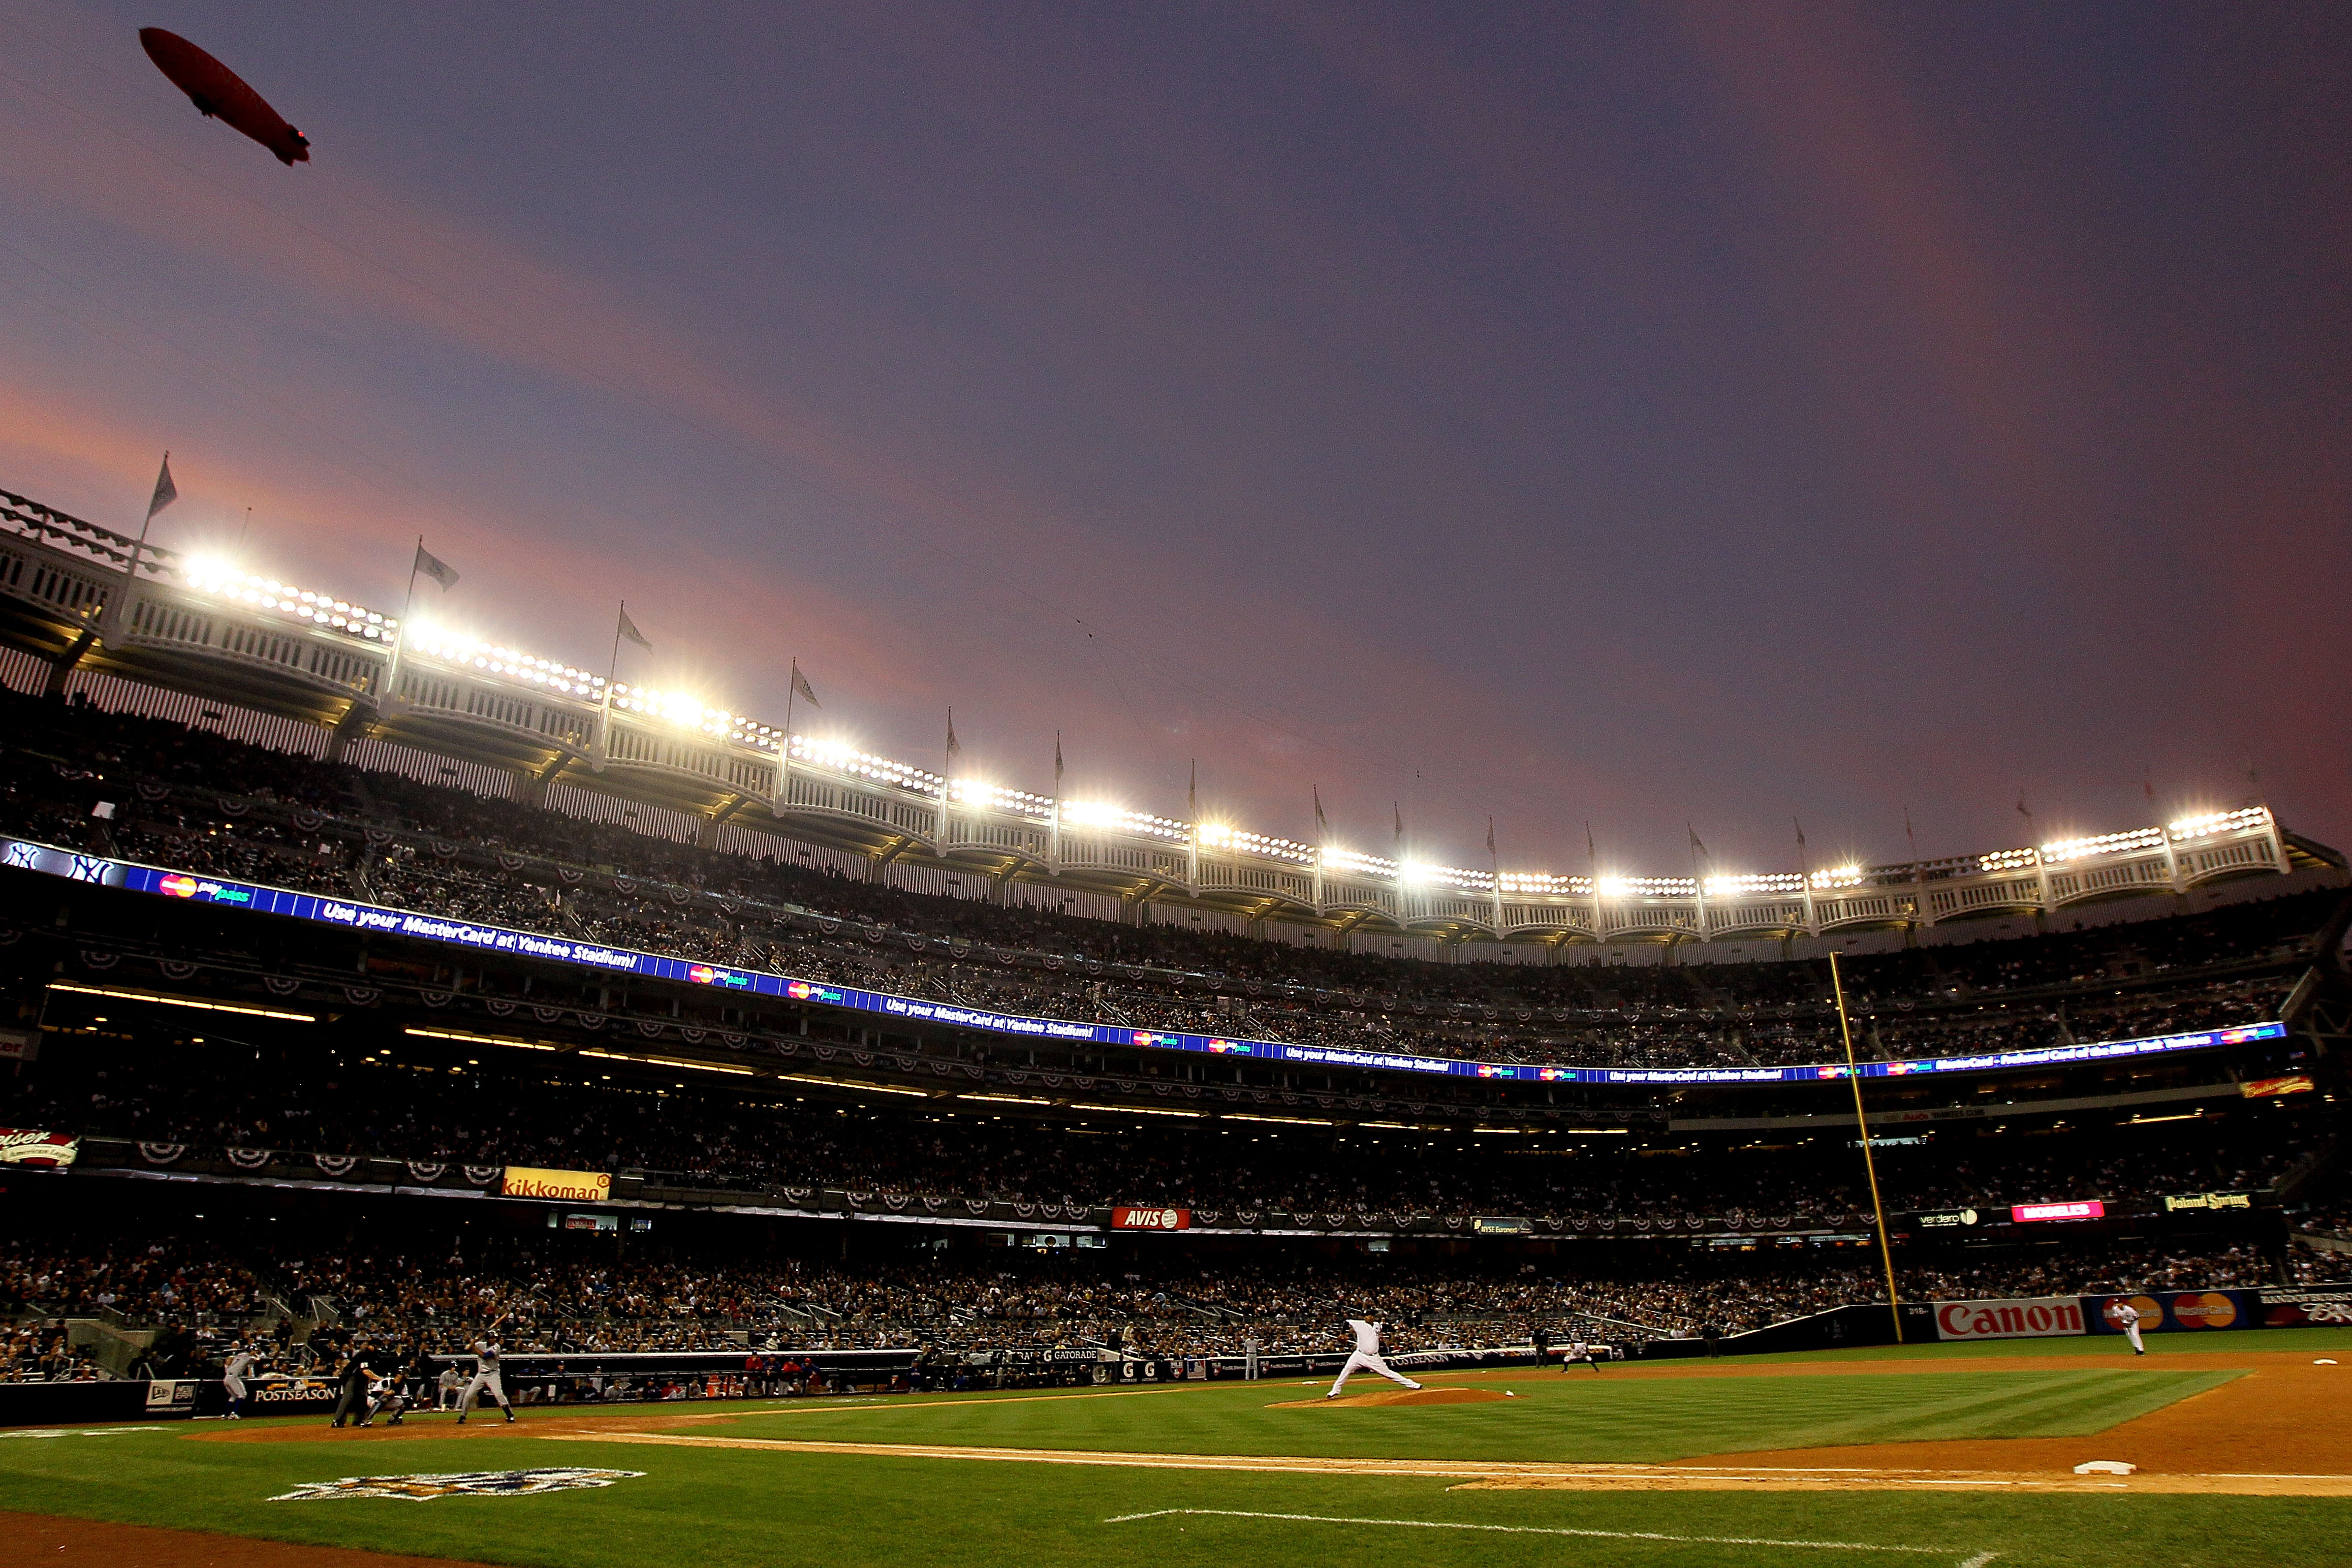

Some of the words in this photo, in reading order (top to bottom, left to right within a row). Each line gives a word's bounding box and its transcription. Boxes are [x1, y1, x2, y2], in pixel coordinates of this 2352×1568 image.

[323, 902, 354, 922] Use
[356, 911, 402, 932] your
[402, 915, 496, 946] MasterCard
[496, 934, 514, 949] at
[517, 935, 571, 959] Yankee
[572, 945, 637, 968] Stadium!
[886, 998, 906, 1012] Use
[907, 1004, 934, 1016] your
[934, 1007, 992, 1026] MasterCard
[993, 1018, 1005, 1029] at
[1007, 1019, 1045, 1033] Yankee
[1046, 1022, 1094, 1038] Stadium!
[1286, 1047, 1304, 1058] Use
[1304, 1051, 1325, 1061] your
[1325, 1051, 1373, 1065] MasterCard
[1373, 1056, 1383, 1065] at
[1384, 1056, 1413, 1069] Yankee
[1414, 1059, 1449, 1072] Stadium!
[1609, 1070, 1625, 1081] Use
[1625, 1072, 1647, 1082] your
[1647, 1071, 1697, 1081] MasterCard
[1697, 1072, 1708, 1081] at
[1709, 1071, 1741, 1081] Yankee
[501, 1178, 600, 1200] kikkoman
[2165, 1194, 2207, 1212] Poland
[2207, 1193, 2251, 1209] Spring
[1124, 1210, 1162, 1226] AVIS
[1938, 1304, 2081, 1335] Canon
[1054, 1351, 1097, 1360] GATORADE
[254, 1388, 337, 1402] POSTSEASON
